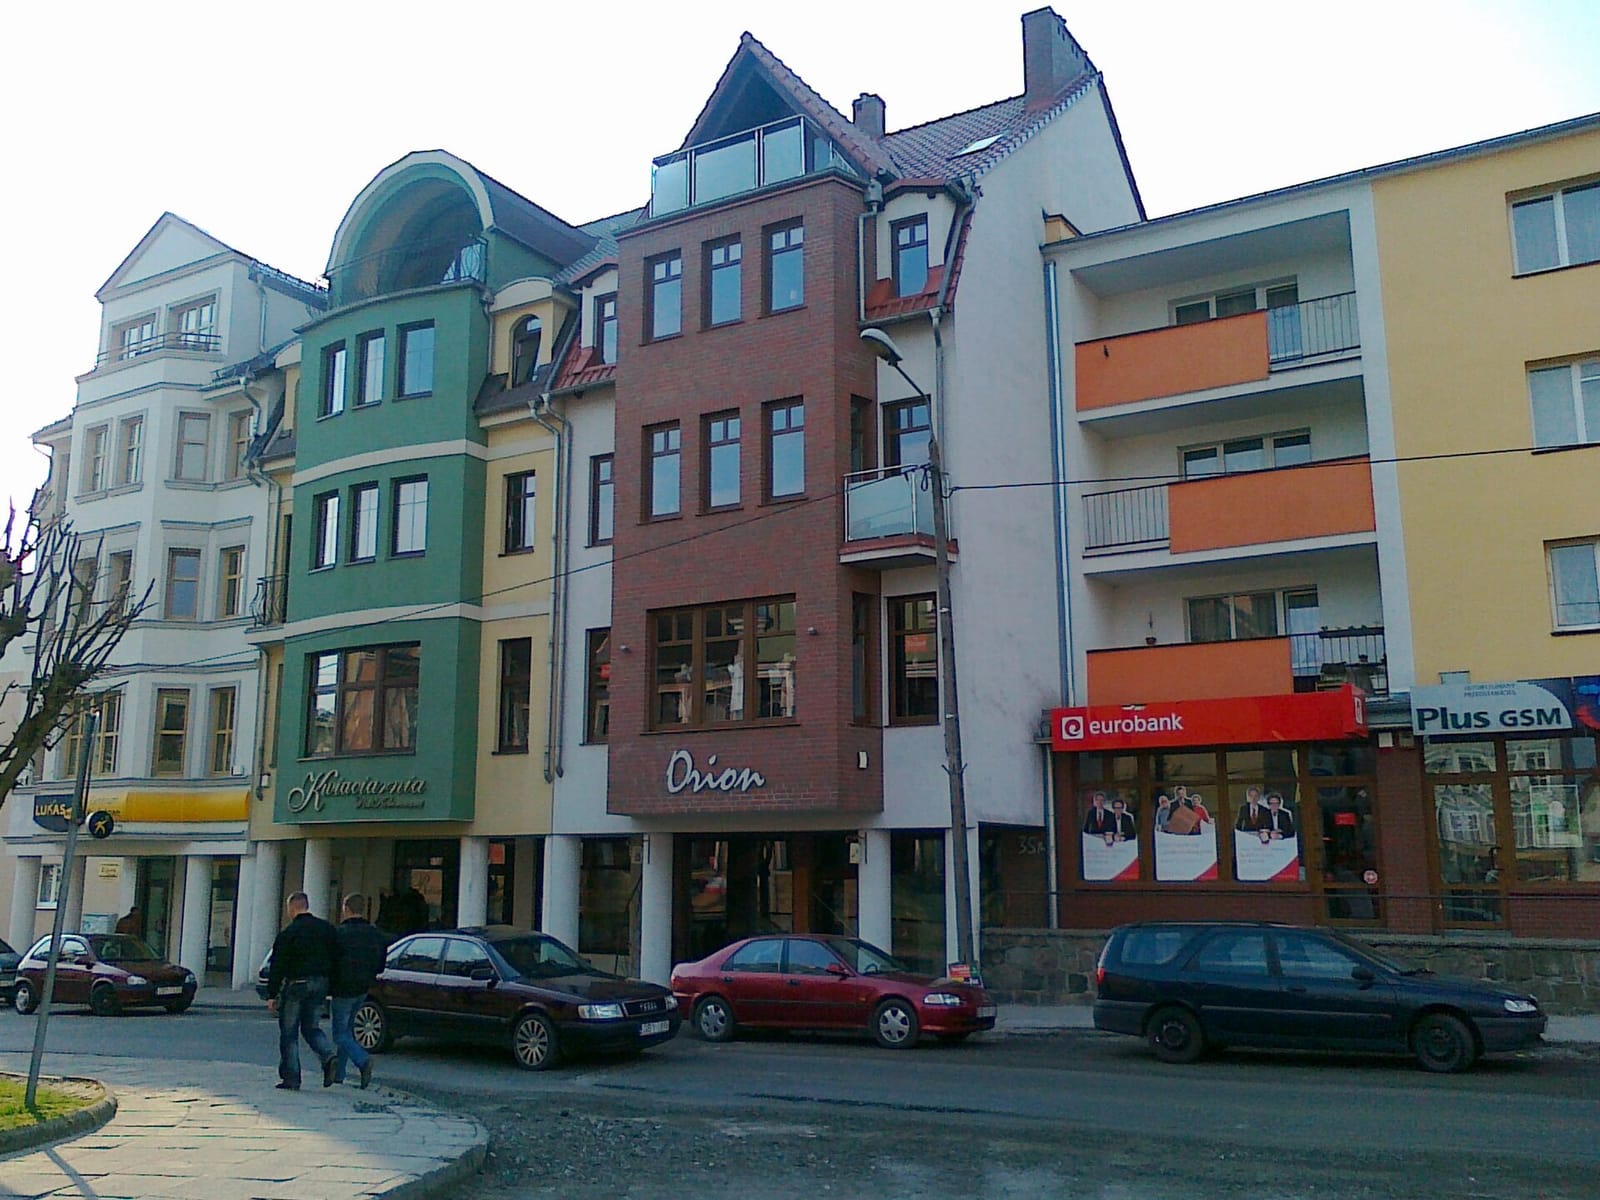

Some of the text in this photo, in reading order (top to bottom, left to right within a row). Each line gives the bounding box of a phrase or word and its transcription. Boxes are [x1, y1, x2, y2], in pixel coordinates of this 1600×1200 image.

[1089, 712, 1184, 735] eurobank
[1416, 707, 1562, 731] Plus GSM
[666, 749, 766, 793] Orion
[287, 769, 426, 812] Kwiaciarnia
[35, 803, 66, 817] LUKAS
